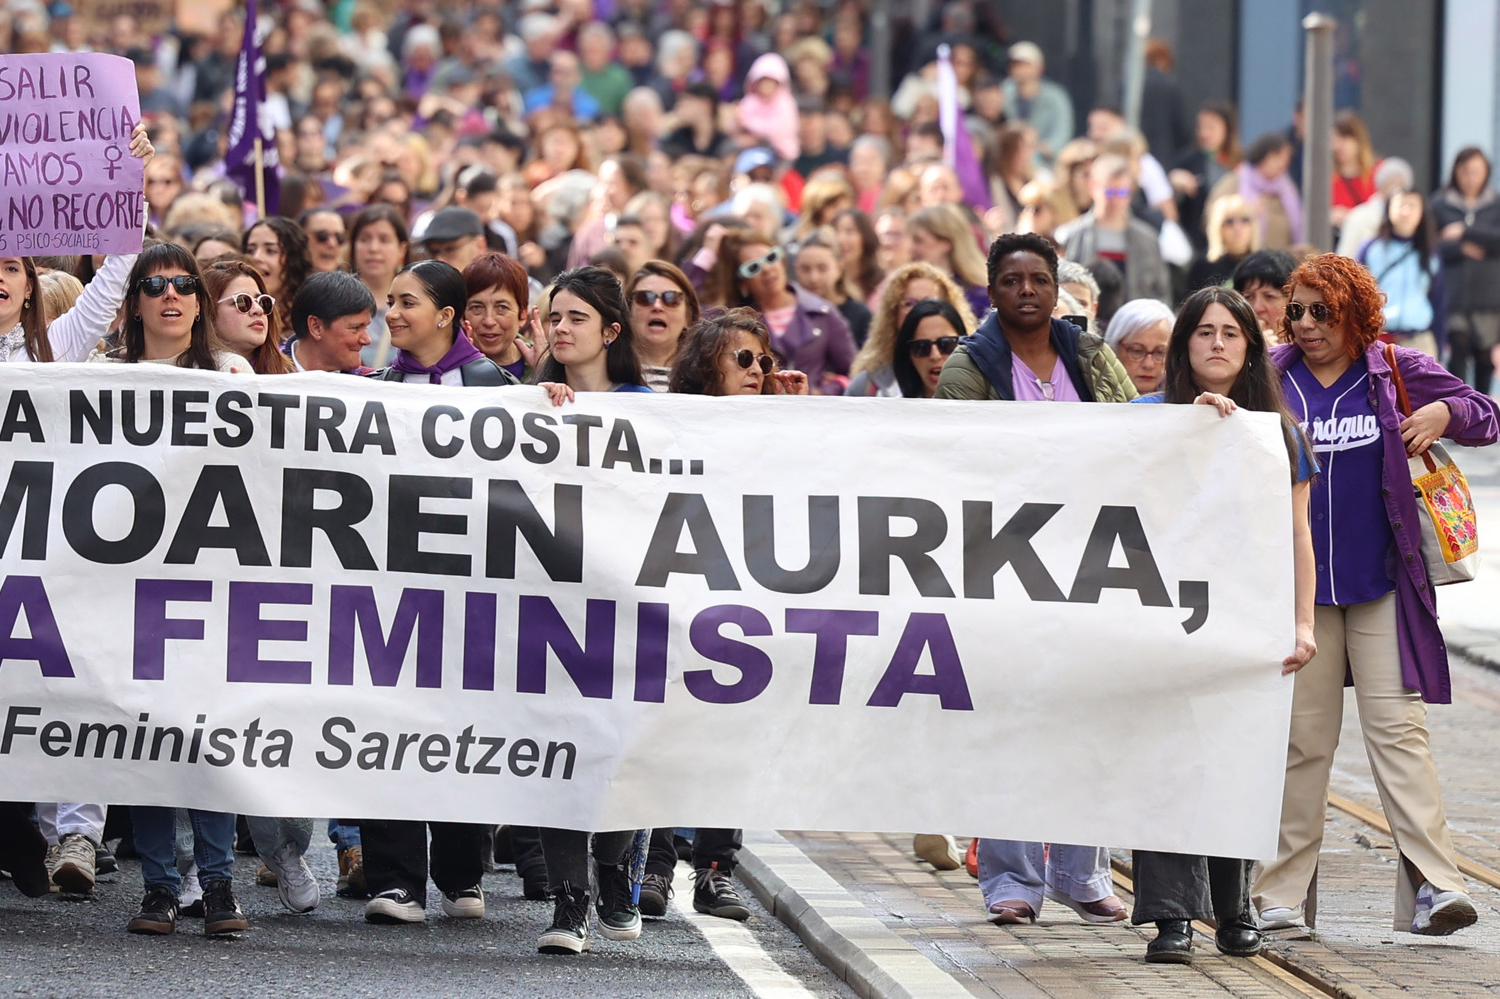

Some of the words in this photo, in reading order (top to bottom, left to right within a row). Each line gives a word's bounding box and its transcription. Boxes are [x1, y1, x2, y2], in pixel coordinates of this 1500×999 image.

[8, 193, 44, 231] NO
[53, 189, 143, 231] RECORTE
[69, 389, 397, 456] NUESTRA
[421, 405, 704, 475] COSTA...
[635, 492, 1210, 635] AURKA,
[132, 578, 975, 711] FEMINISTA
[0, 706, 294, 768] Feminista
[315, 715, 577, 780] Saretzen
